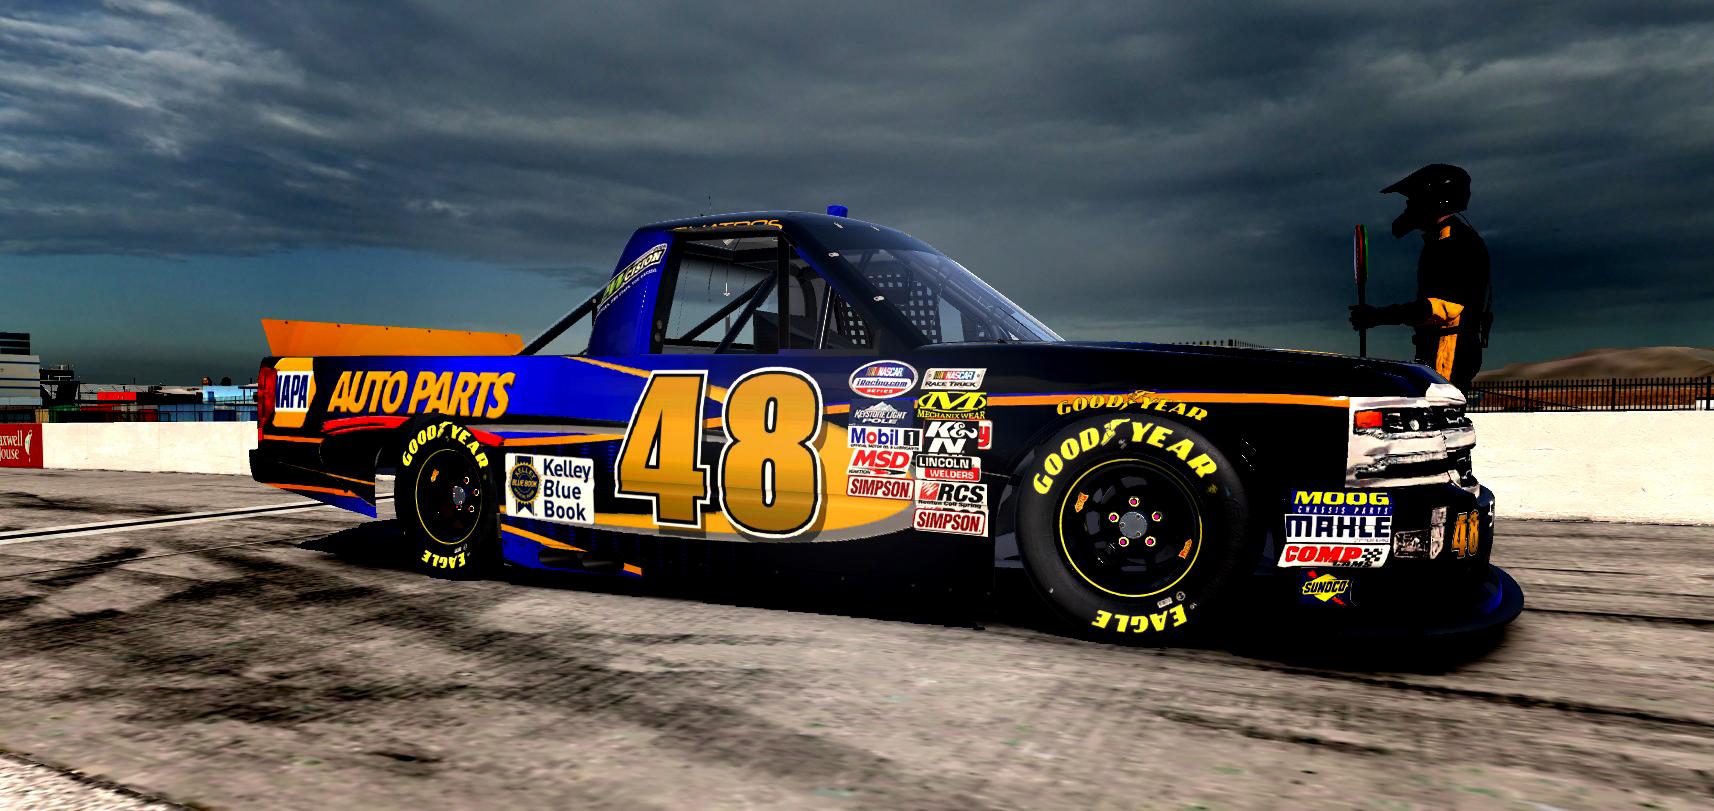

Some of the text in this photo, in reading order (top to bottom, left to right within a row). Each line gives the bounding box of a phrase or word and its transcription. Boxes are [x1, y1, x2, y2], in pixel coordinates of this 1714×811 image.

[877, 366, 903, 377] NASCAR
[946, 370, 976, 380] NASCAR
[327, 370, 516, 419] AUTO PARTS
[886, 411, 907, 420] LIGHT
[917, 409, 986, 420] MECHANIX WEAR
[850, 427, 899, 446] Mobil
[615, 366, 823, 538] 48
[852, 450, 910, 469] MSD
[543, 458, 591, 483] Kelley
[919, 457, 969, 469] LINCOLN
[929, 469, 975, 479] WELDERS
[543, 479, 582, 499] Blue
[850, 478, 911, 498] SIMPSON
[937, 484, 984, 503] RCS
[1294, 491, 1390, 505] MOOG
[544, 500, 586, 521] Book
[1297, 506, 1390, 515] CHASSIS PARTS
[917, 512, 981, 532] SIMPSON
[1285, 516, 1391, 538] MAHLE
[1451, 509, 1480, 558] 48
[421, 549, 466, 569] EAGLE
[1285, 545, 1363, 563] COMP
[1303, 578, 1348, 594] SUNOCO
[1091, 604, 1188, 633] EAGLE
